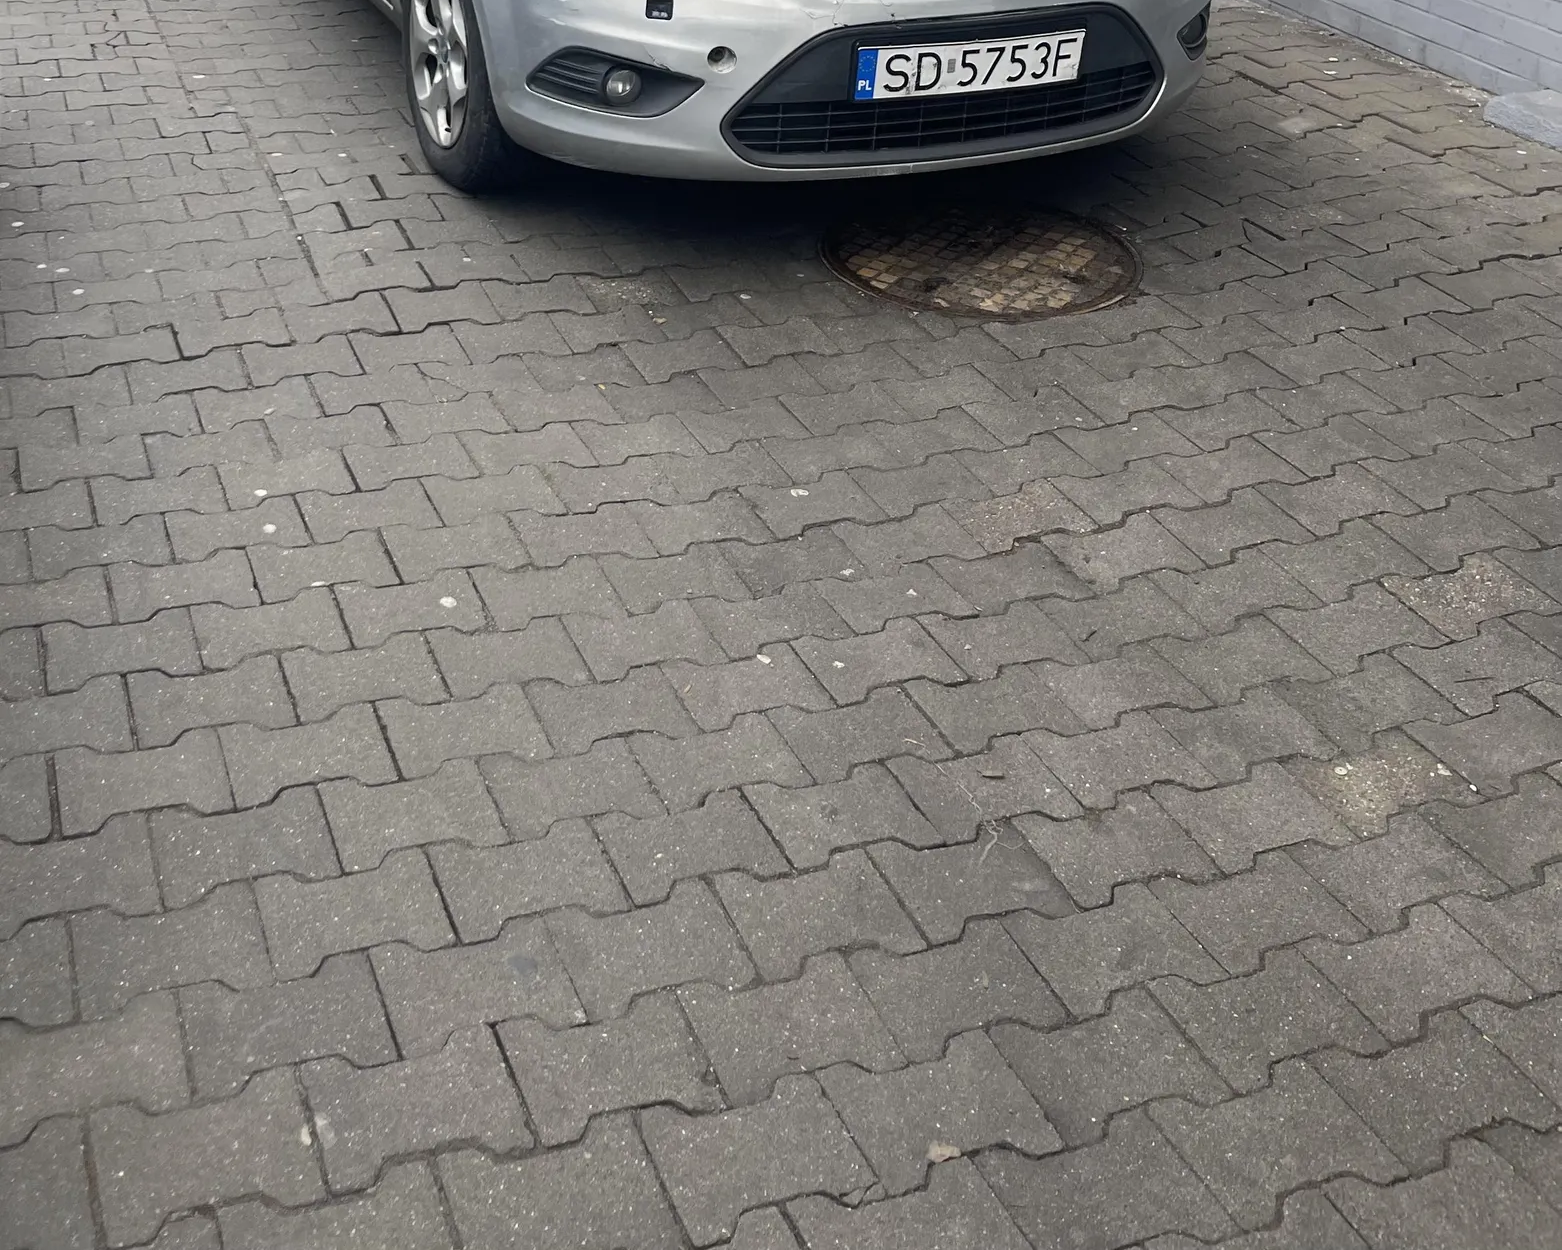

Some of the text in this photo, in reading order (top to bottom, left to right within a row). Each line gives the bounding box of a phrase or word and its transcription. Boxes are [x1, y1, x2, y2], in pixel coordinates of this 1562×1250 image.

[883, 37, 1078, 93] SD 5753F
[857, 79, 873, 91] PL
